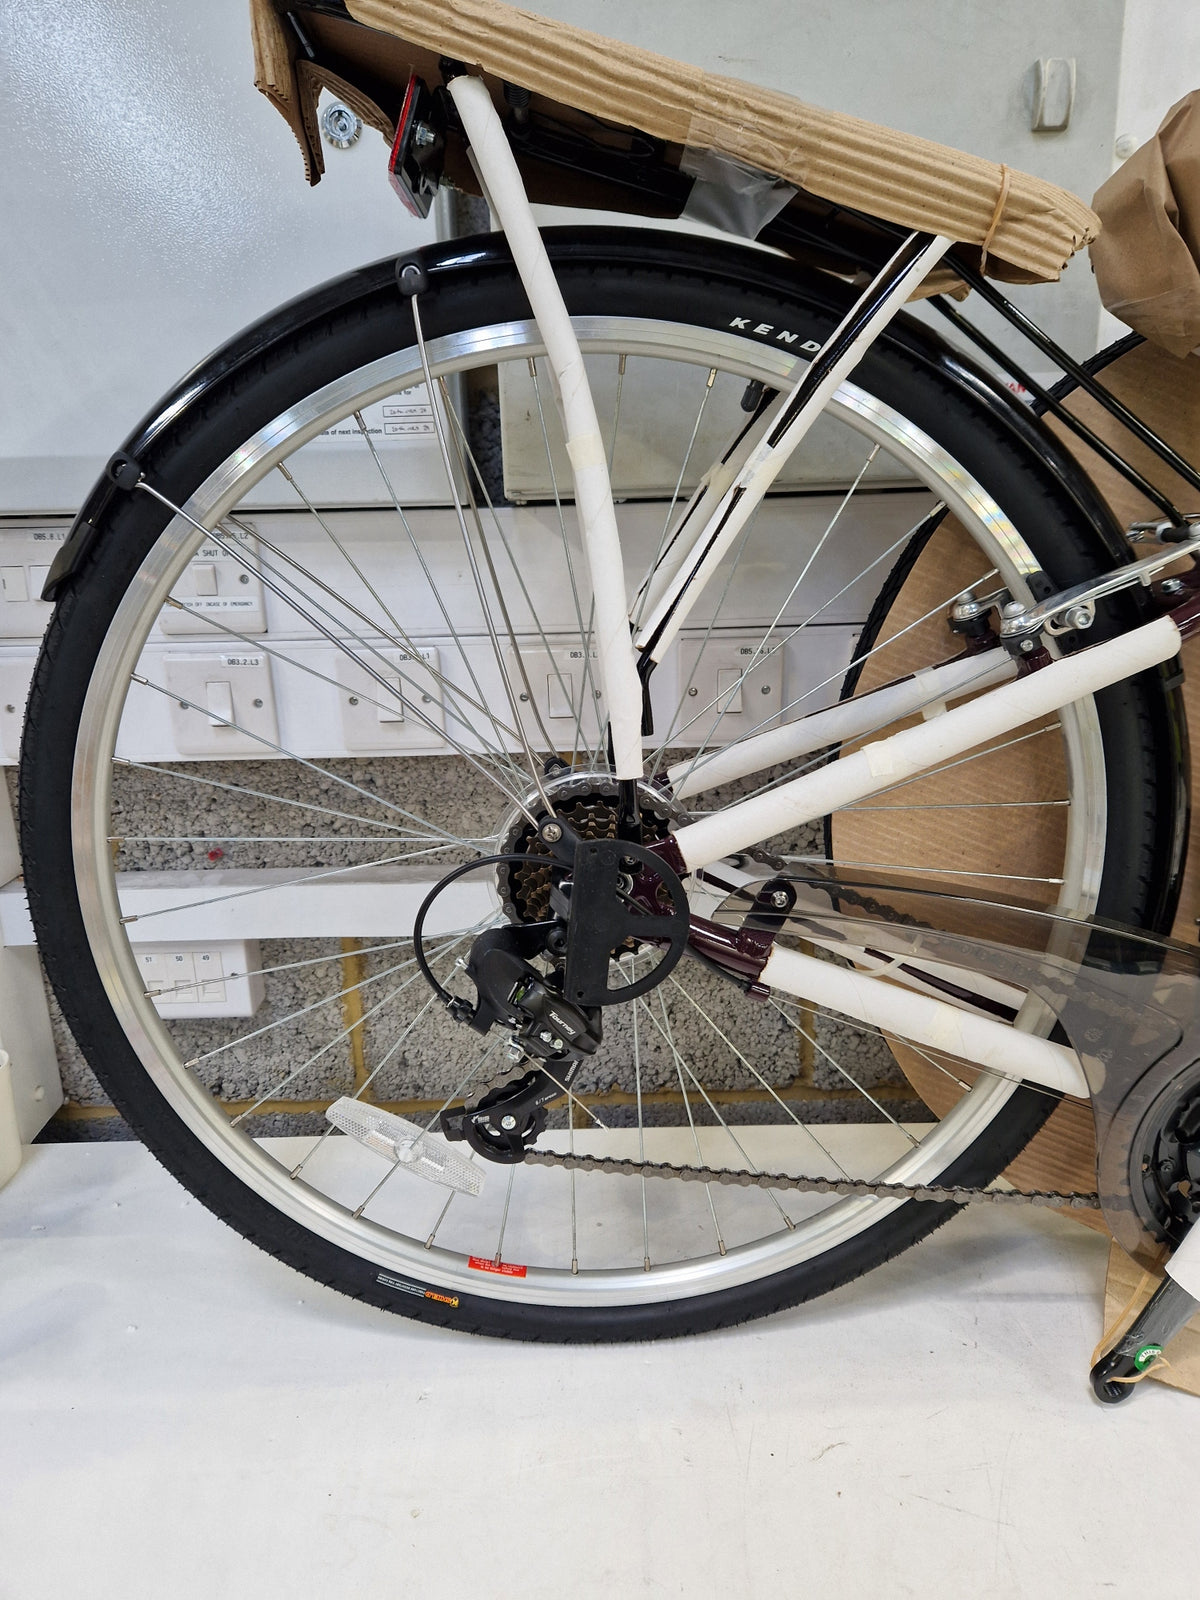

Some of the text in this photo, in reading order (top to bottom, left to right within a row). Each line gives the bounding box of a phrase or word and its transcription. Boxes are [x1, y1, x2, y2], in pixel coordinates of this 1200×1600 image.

[728, 317, 822, 352] KEND
[202, 549, 219, 557] SHUT
[549, 1010, 576, 1036] Tourney
